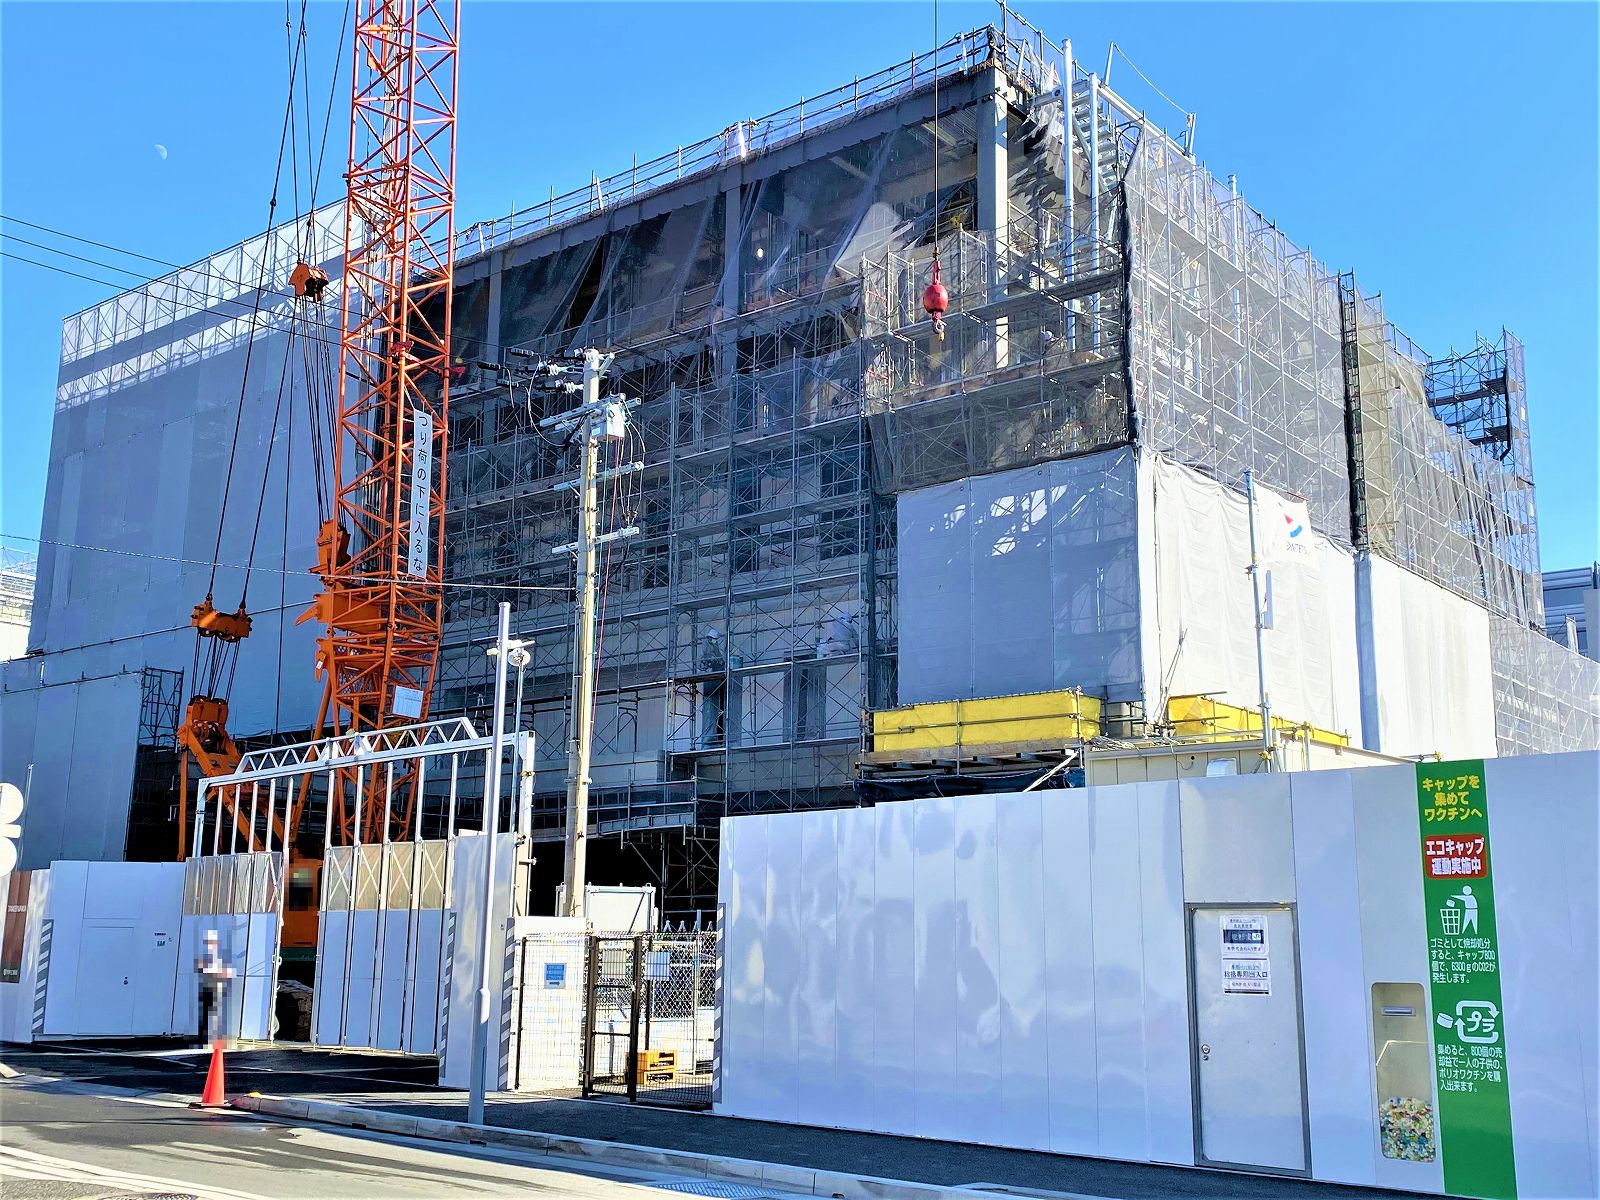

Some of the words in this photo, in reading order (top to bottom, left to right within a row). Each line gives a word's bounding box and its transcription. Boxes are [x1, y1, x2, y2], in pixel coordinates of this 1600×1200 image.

[413, 416, 429, 572] つり荷の下に入るな
[1422, 775, 1480, 791] キャップを
[1434, 792, 1470, 807] 集めて
[1424, 807, 1482, 822] ワクチンへ
[1426, 837, 1485, 856] エコキャップ
[1431, 857, 1482, 876] 運動実施中
[1430, 937, 1491, 949] ゴミとして焼却処分
[1432, 972, 1470, 984] 発生します。
[1467, 1011, 1495, 1032] プラ
[1440, 1080, 1478, 1093] 入出来ます。
